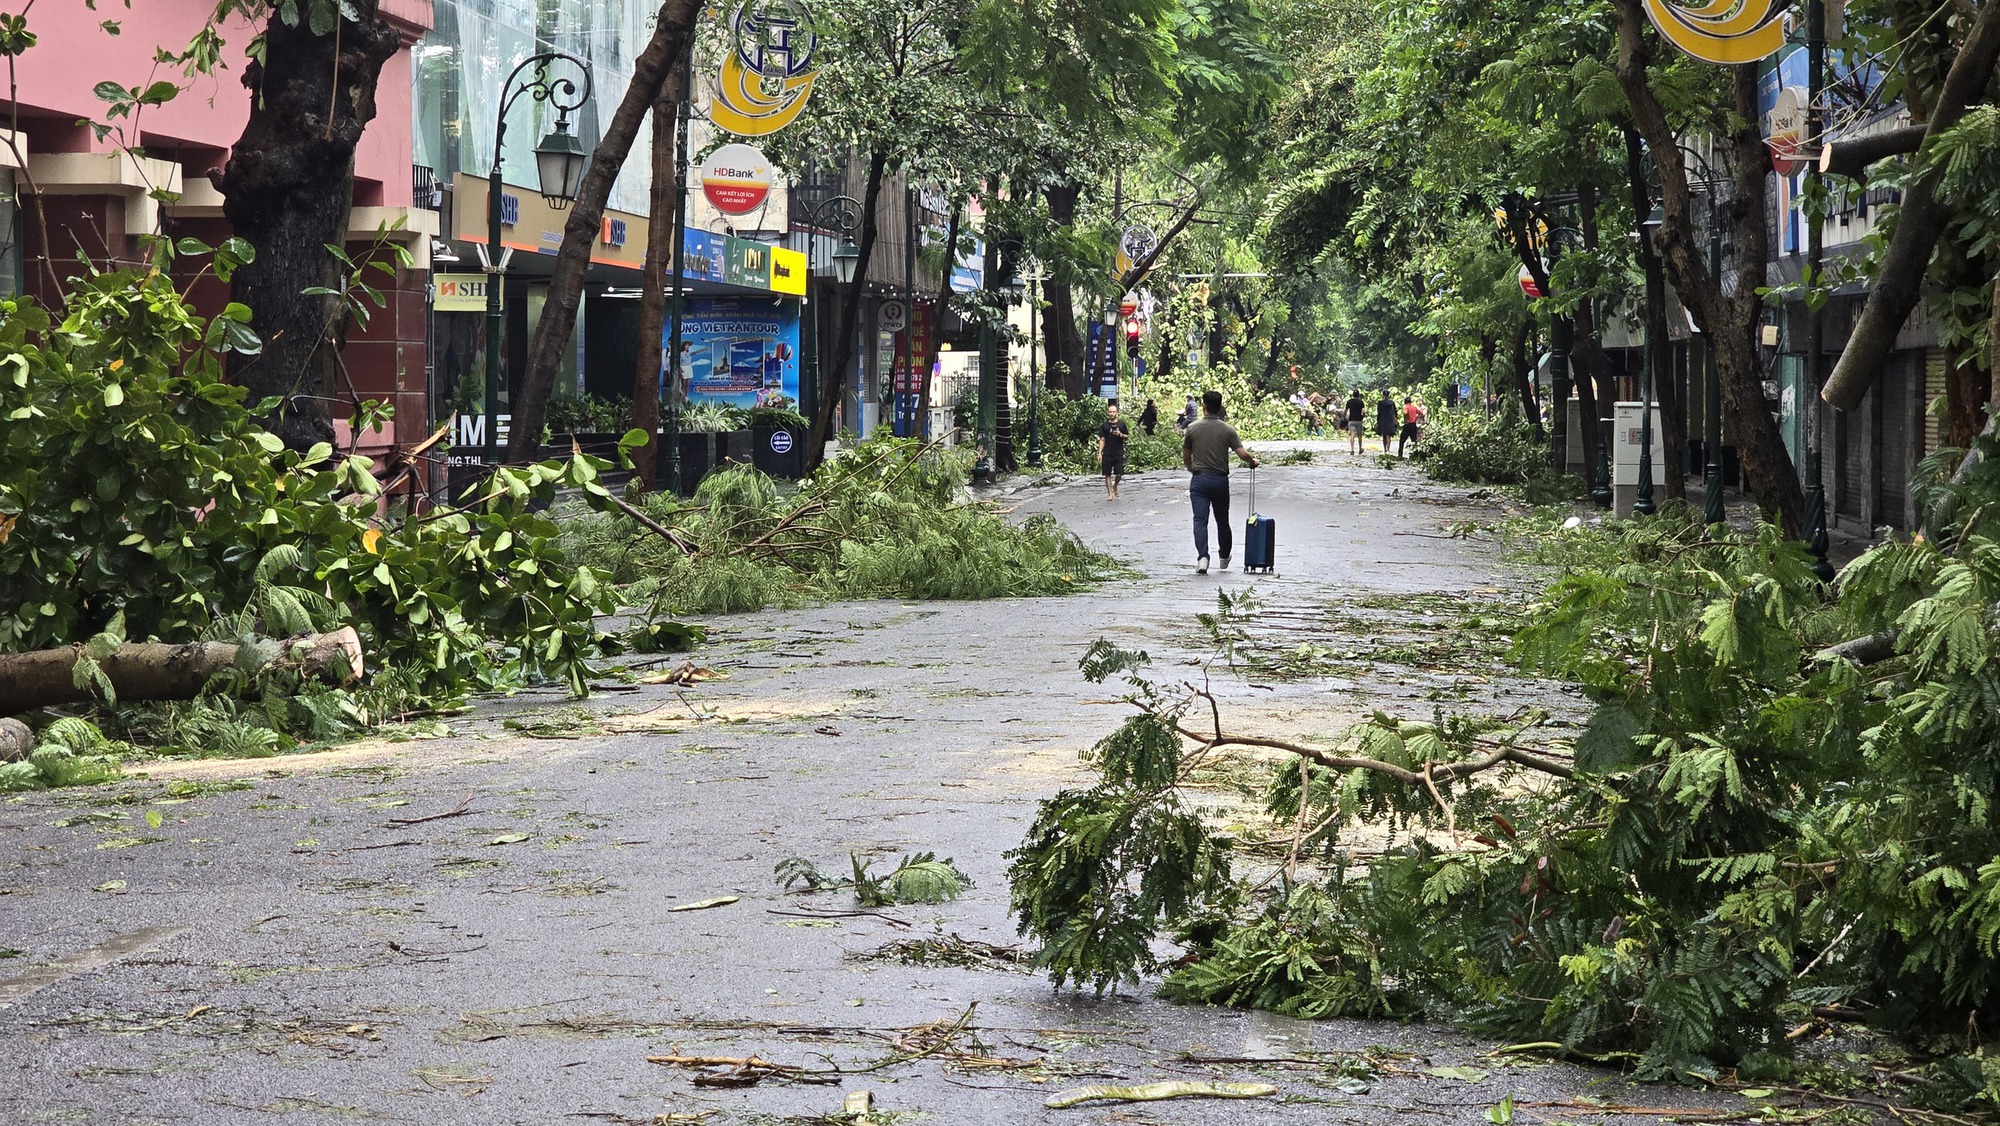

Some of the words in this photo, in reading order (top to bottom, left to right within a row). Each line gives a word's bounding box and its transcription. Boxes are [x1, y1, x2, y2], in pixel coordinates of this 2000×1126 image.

[714, 167, 754, 178] HDBank
[459, 282, 488, 296] SH
[702, 321, 780, 335] VIETRANTOUR
